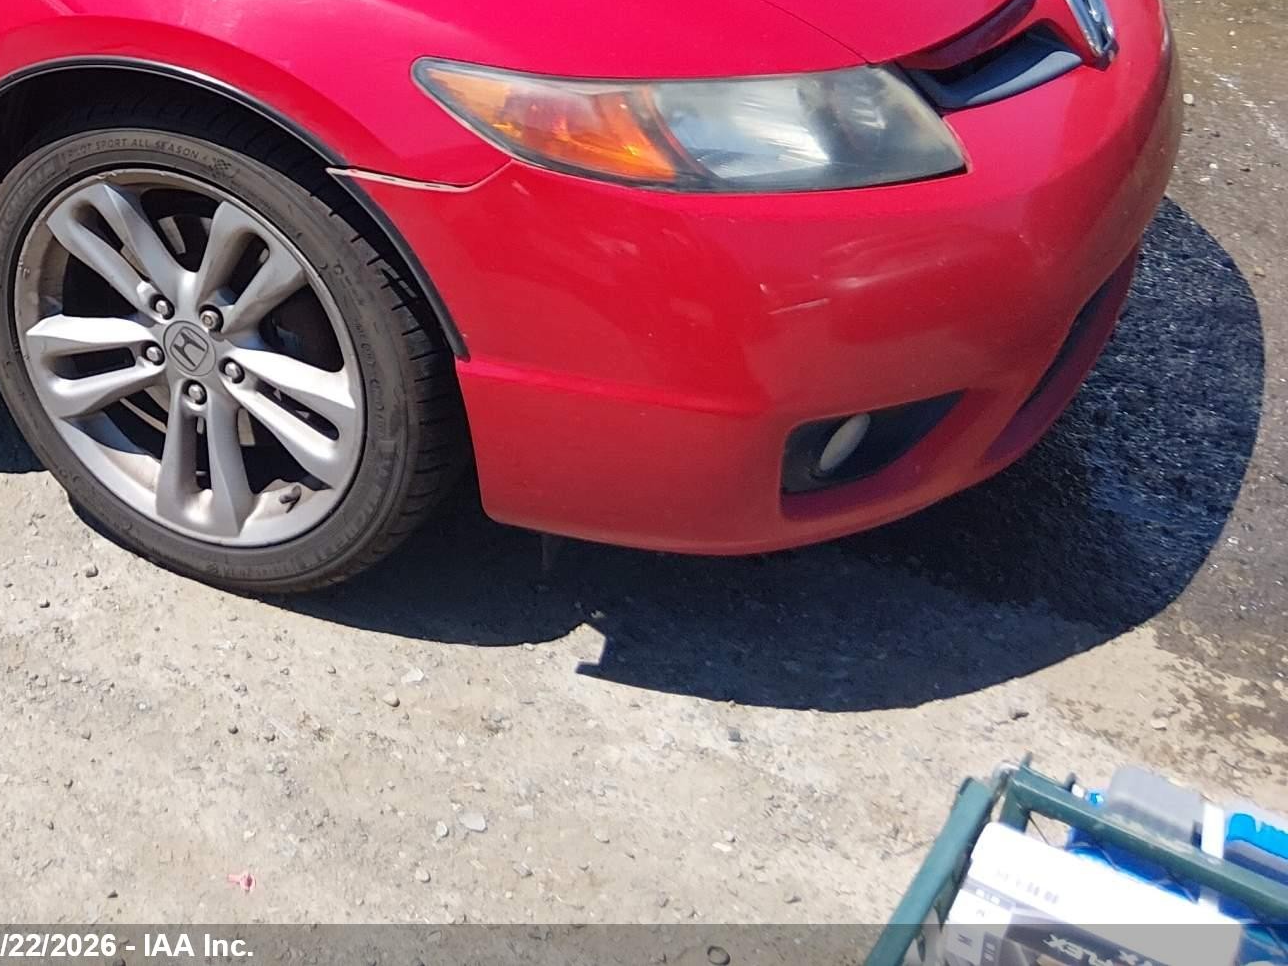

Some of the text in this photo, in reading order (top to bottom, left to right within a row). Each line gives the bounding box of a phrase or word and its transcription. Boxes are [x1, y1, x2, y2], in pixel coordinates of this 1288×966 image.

[95, 138, 128, 150] SPORT
[132, 138, 150, 147] ALL
[155, 140, 200, 159] SEASON
